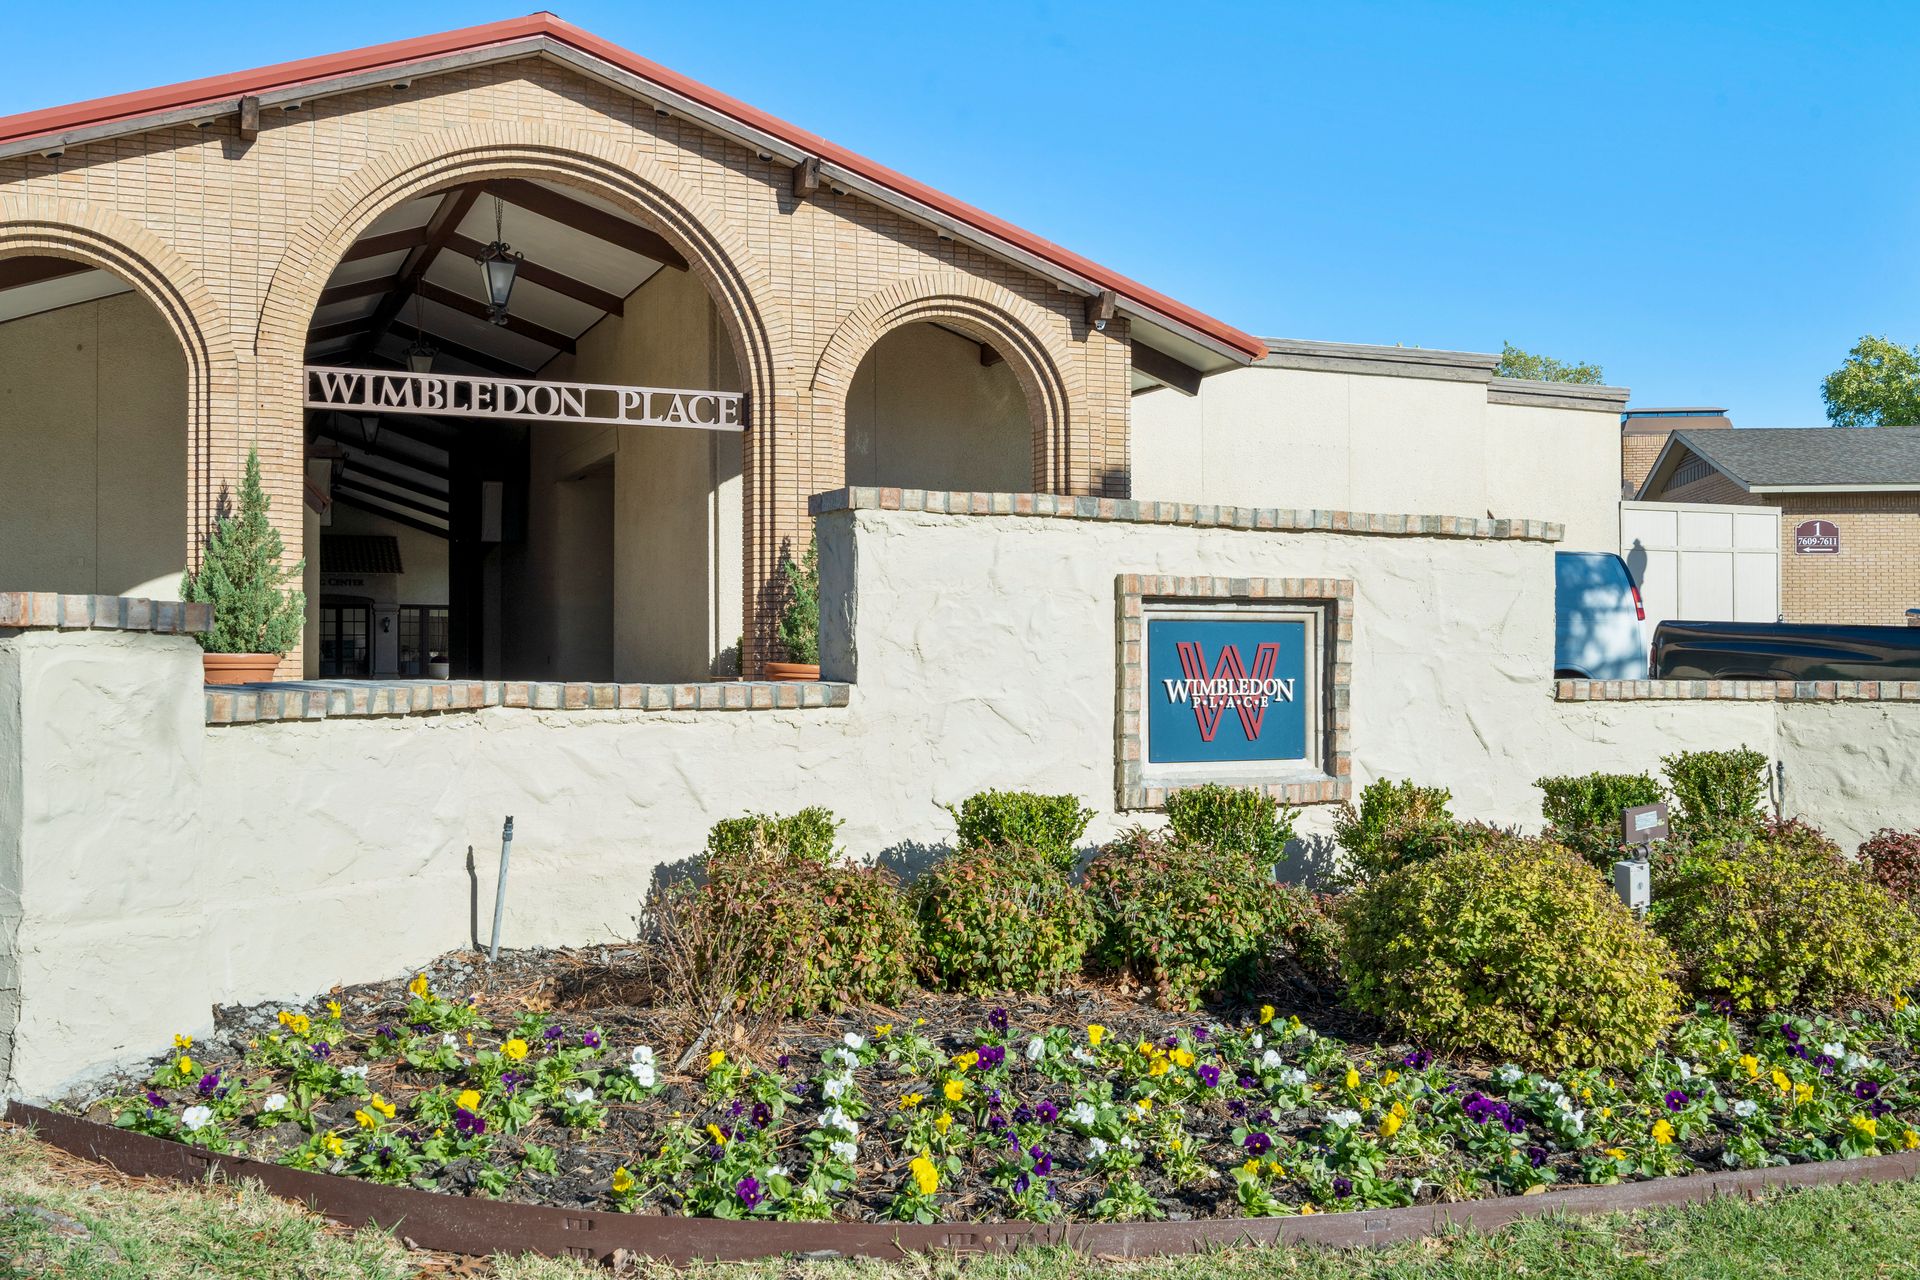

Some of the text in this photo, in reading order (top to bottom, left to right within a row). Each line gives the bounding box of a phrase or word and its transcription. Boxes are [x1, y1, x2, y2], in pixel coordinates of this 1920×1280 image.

[316, 371, 739, 426] WIMBLEDON PLACE
[1813, 521, 1822, 537] 1
[1163, 678, 1296, 704] WIMBLEDON
